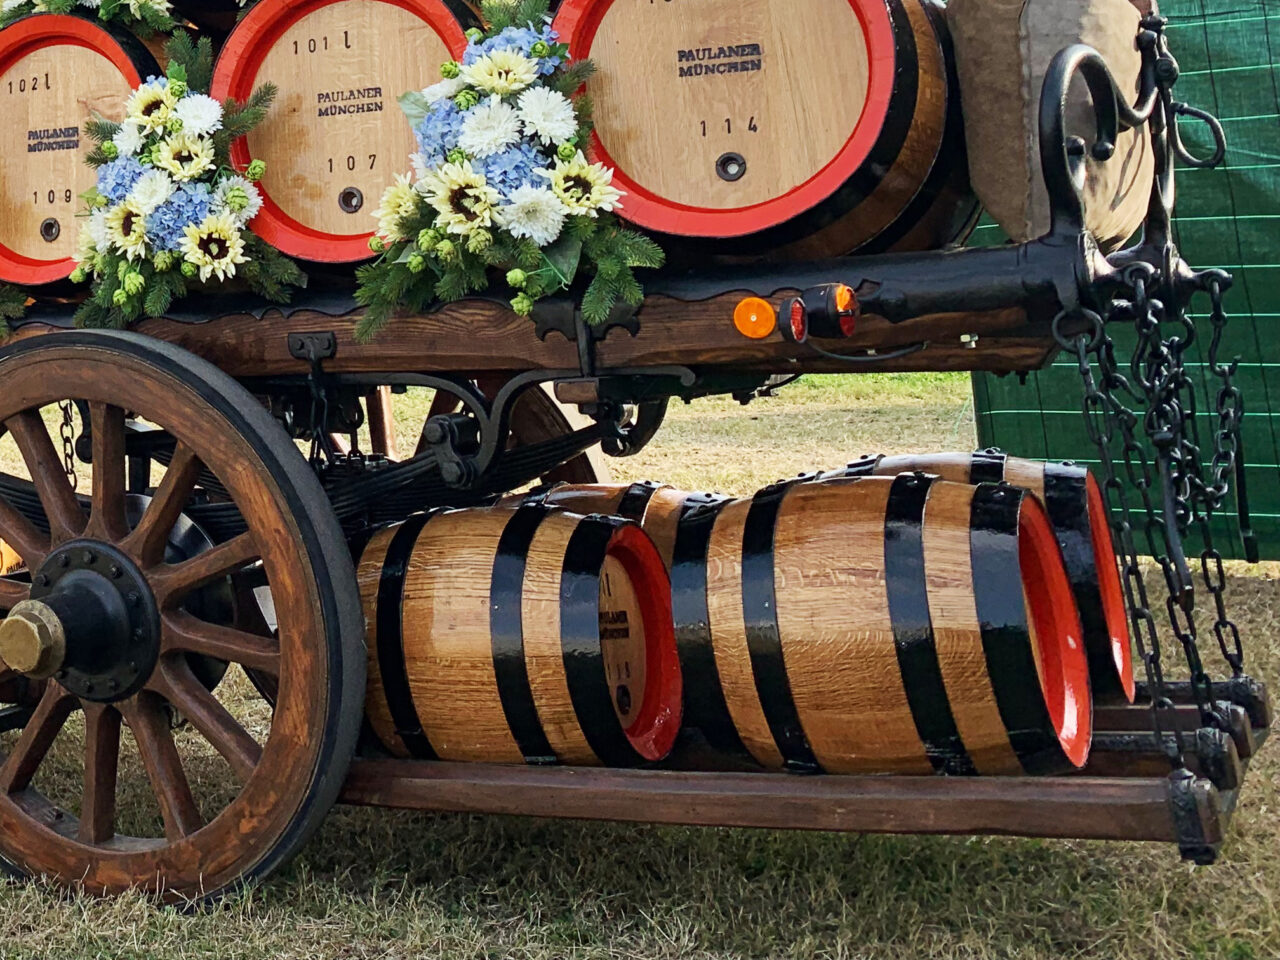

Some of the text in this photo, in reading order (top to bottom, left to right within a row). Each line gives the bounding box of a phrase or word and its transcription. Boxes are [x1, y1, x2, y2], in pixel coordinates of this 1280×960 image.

[677, 43, 762, 62] PAULANER
[678, 59, 762, 77] MÜNCHEN
[317, 86, 383, 104] PAULANER
[317, 101, 384, 118] MÜNCHEN
[27, 126, 80, 141] PAULANER
[27, 139, 80, 153] MÜNCHEN
